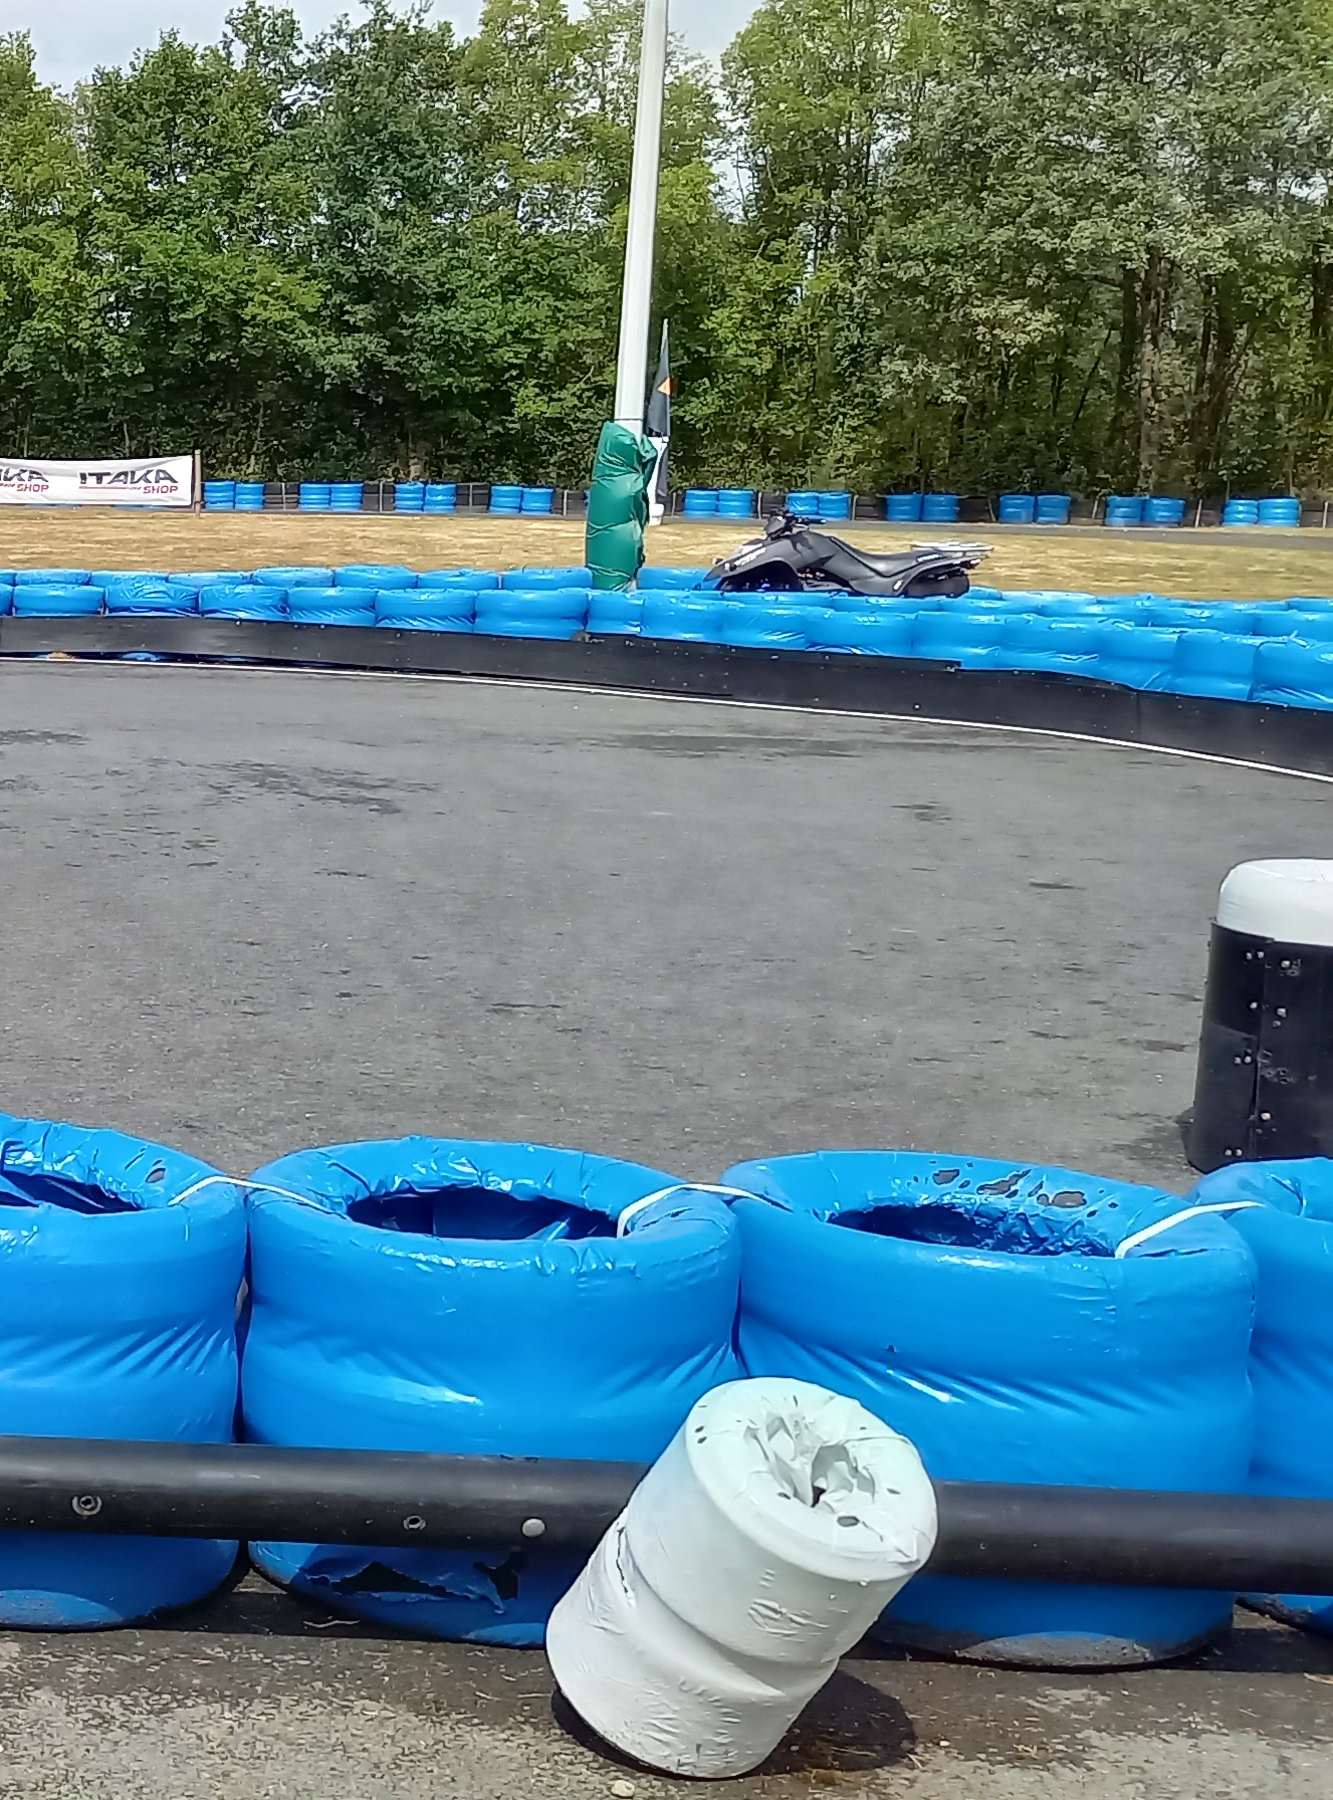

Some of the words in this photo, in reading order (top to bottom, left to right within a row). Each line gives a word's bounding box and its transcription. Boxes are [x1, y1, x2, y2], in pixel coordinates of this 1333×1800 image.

[79, 469, 179, 485] ITAKA
[16, 483, 50, 493] SHOP
[142, 485, 179, 495] SHOP
